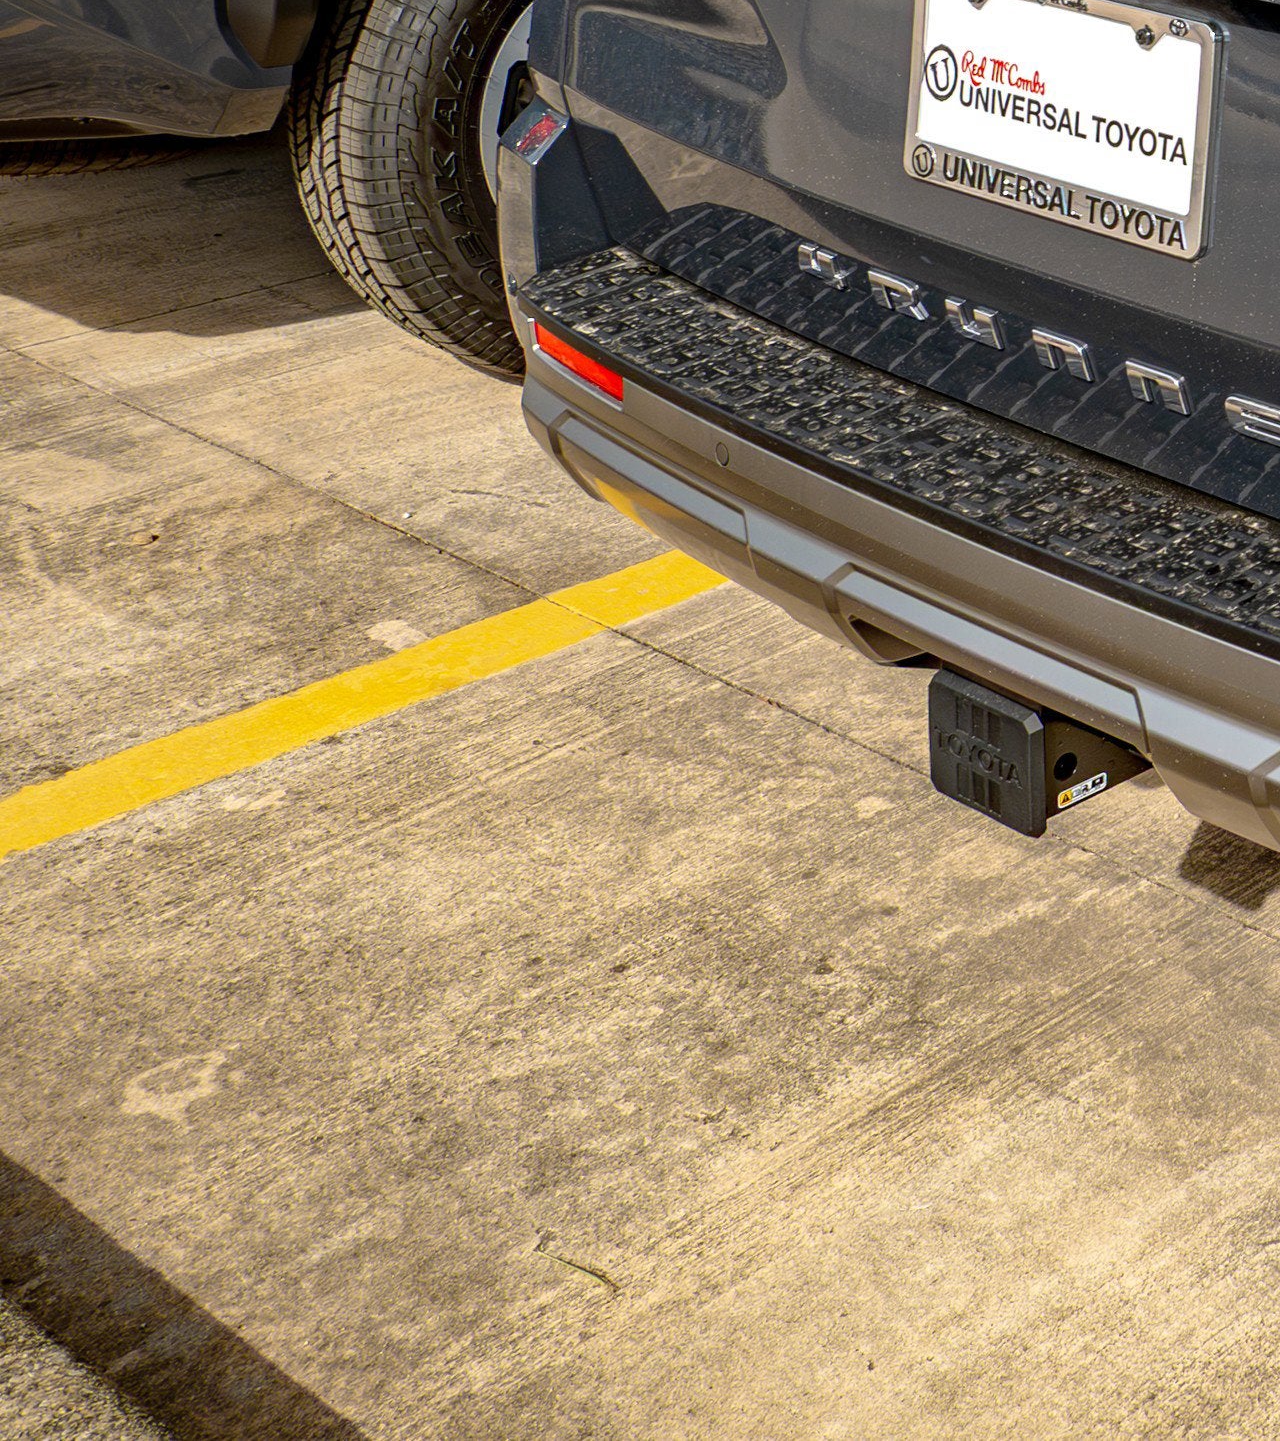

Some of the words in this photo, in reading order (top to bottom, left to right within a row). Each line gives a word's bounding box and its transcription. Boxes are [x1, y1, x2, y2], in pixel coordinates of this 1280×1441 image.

[961, 50, 986, 87] Red
[989, 58, 1046, 95] McCombs
[959, 80, 1087, 140] UNIVERSAL
[1092, 115, 1188, 166] TOYOTA
[943, 153, 1081, 221] UNIVERSAL
[1086, 195, 1189, 251] TOYOTA
[934, 726, 1024, 791] TOYOTA
